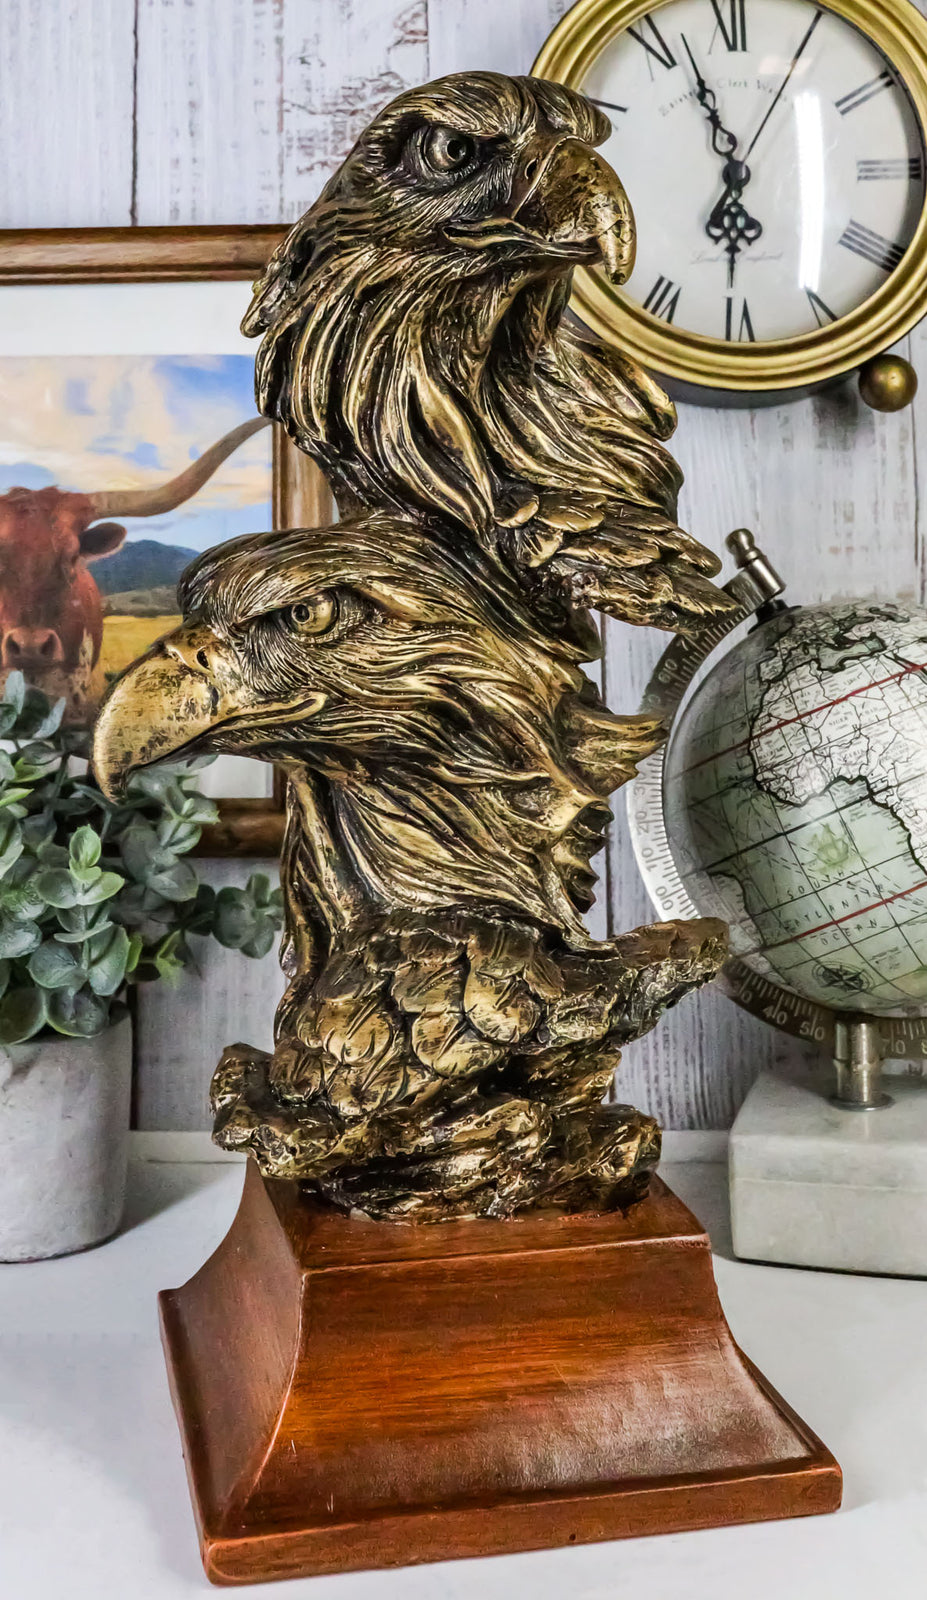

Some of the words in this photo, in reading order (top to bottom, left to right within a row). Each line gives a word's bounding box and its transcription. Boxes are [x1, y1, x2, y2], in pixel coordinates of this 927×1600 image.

[708, 0, 748, 55] XII
[834, 69, 898, 117] II
[856, 157, 921, 183] III
[838, 218, 906, 274] IIII
[725, 296, 756, 342] VI
[804, 284, 839, 328] V
[762, 1005, 788, 1025] 40
[799, 1020, 826, 1041] 50
